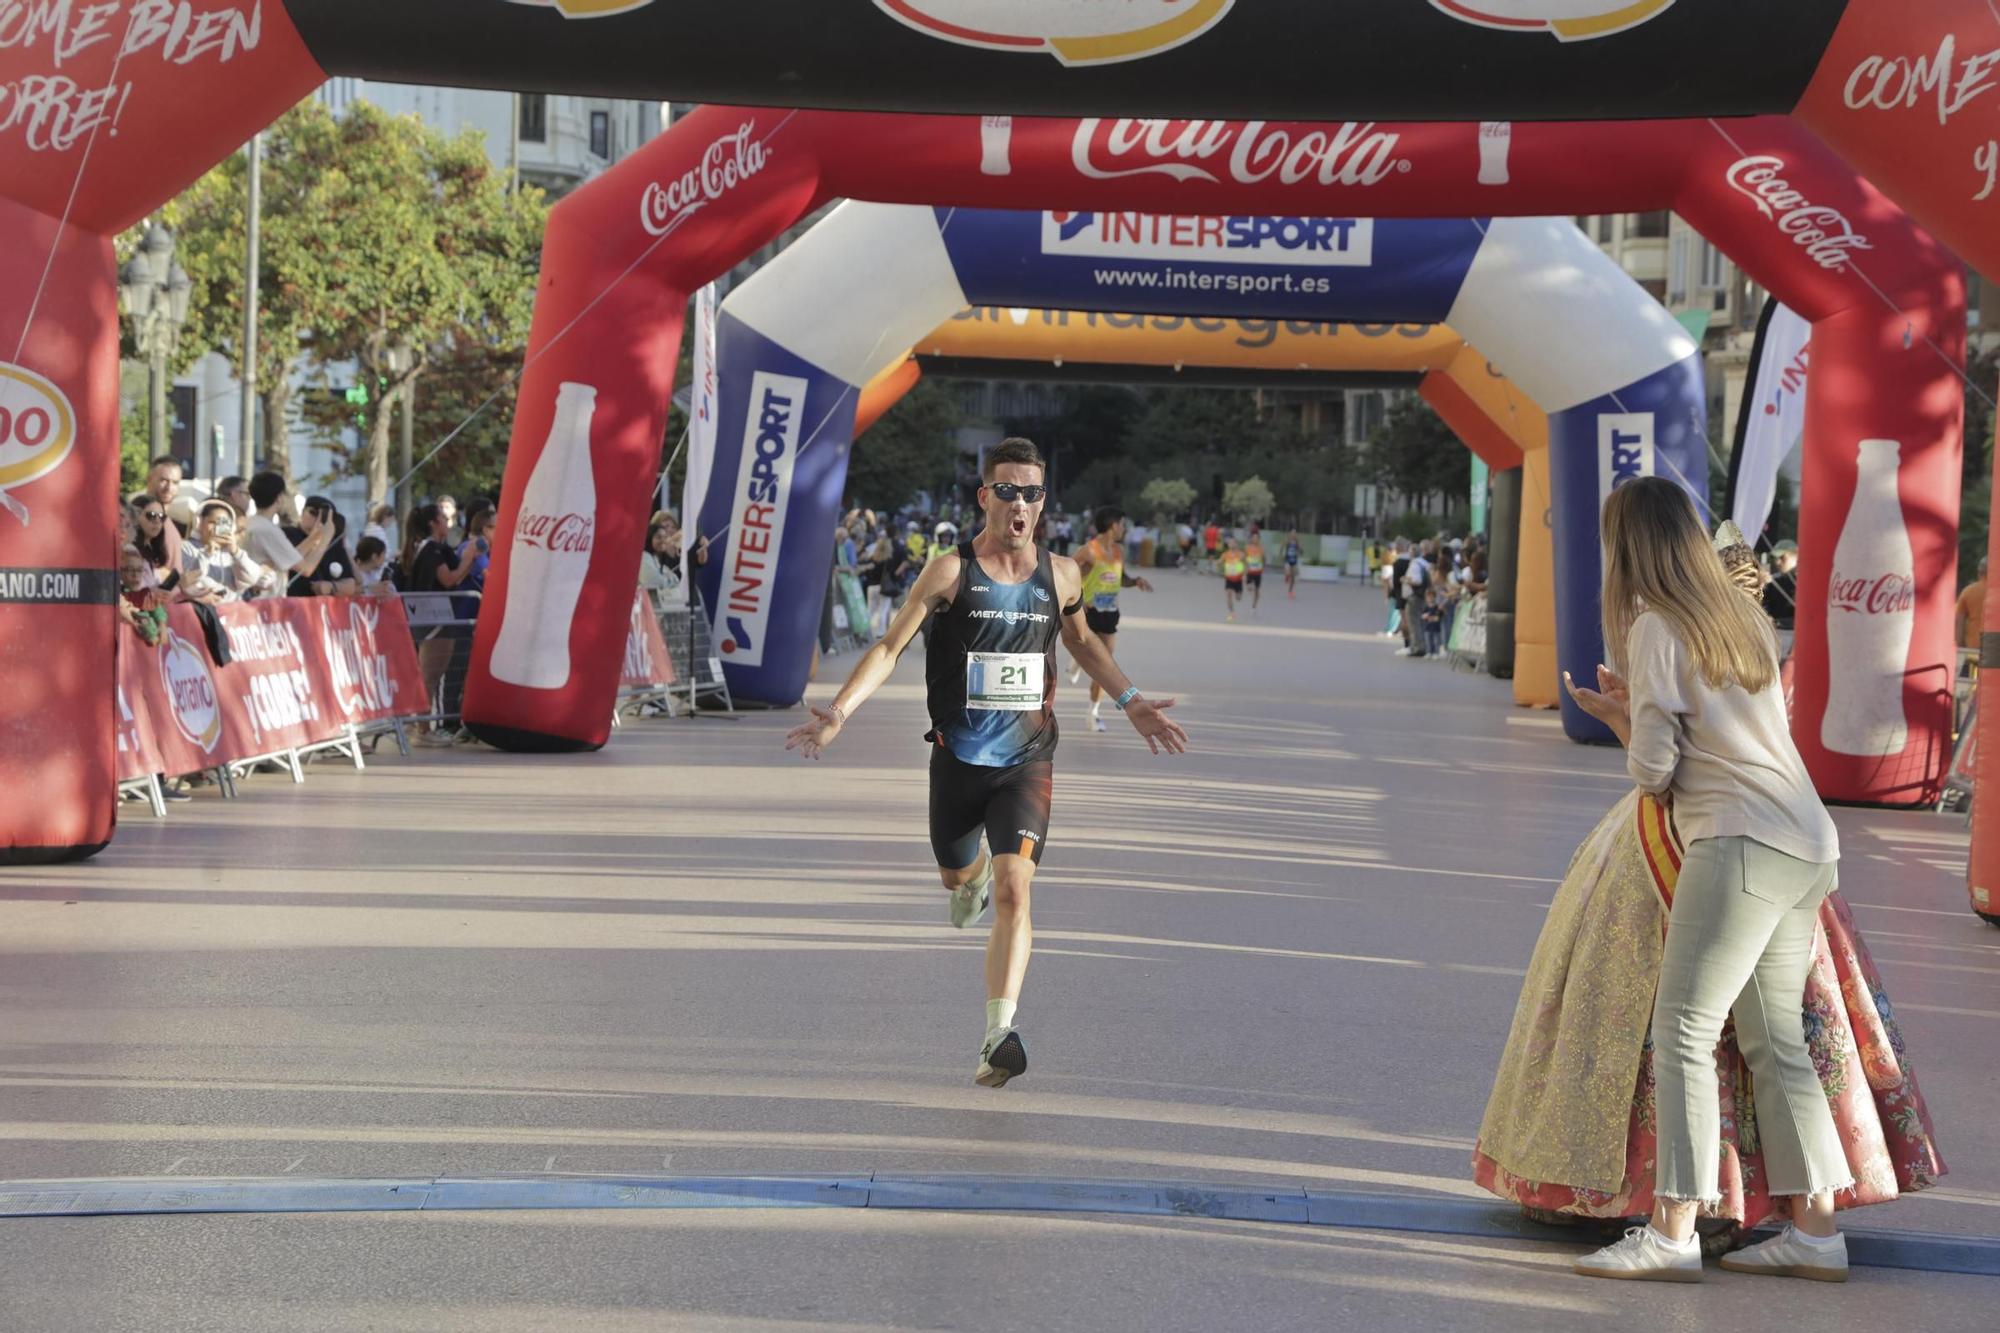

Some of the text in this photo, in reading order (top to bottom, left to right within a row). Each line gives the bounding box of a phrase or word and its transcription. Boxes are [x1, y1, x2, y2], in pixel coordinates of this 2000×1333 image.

[0, 0, 261, 68] OME BIEN
[1844, 33, 2000, 125] COME
[1101, 211, 1357, 251] INTERSPORT
[1093, 267, 1331, 294] www.intersport.es
[728, 387, 792, 613] INTERSPORT
[1000, 666, 1027, 685] 21
